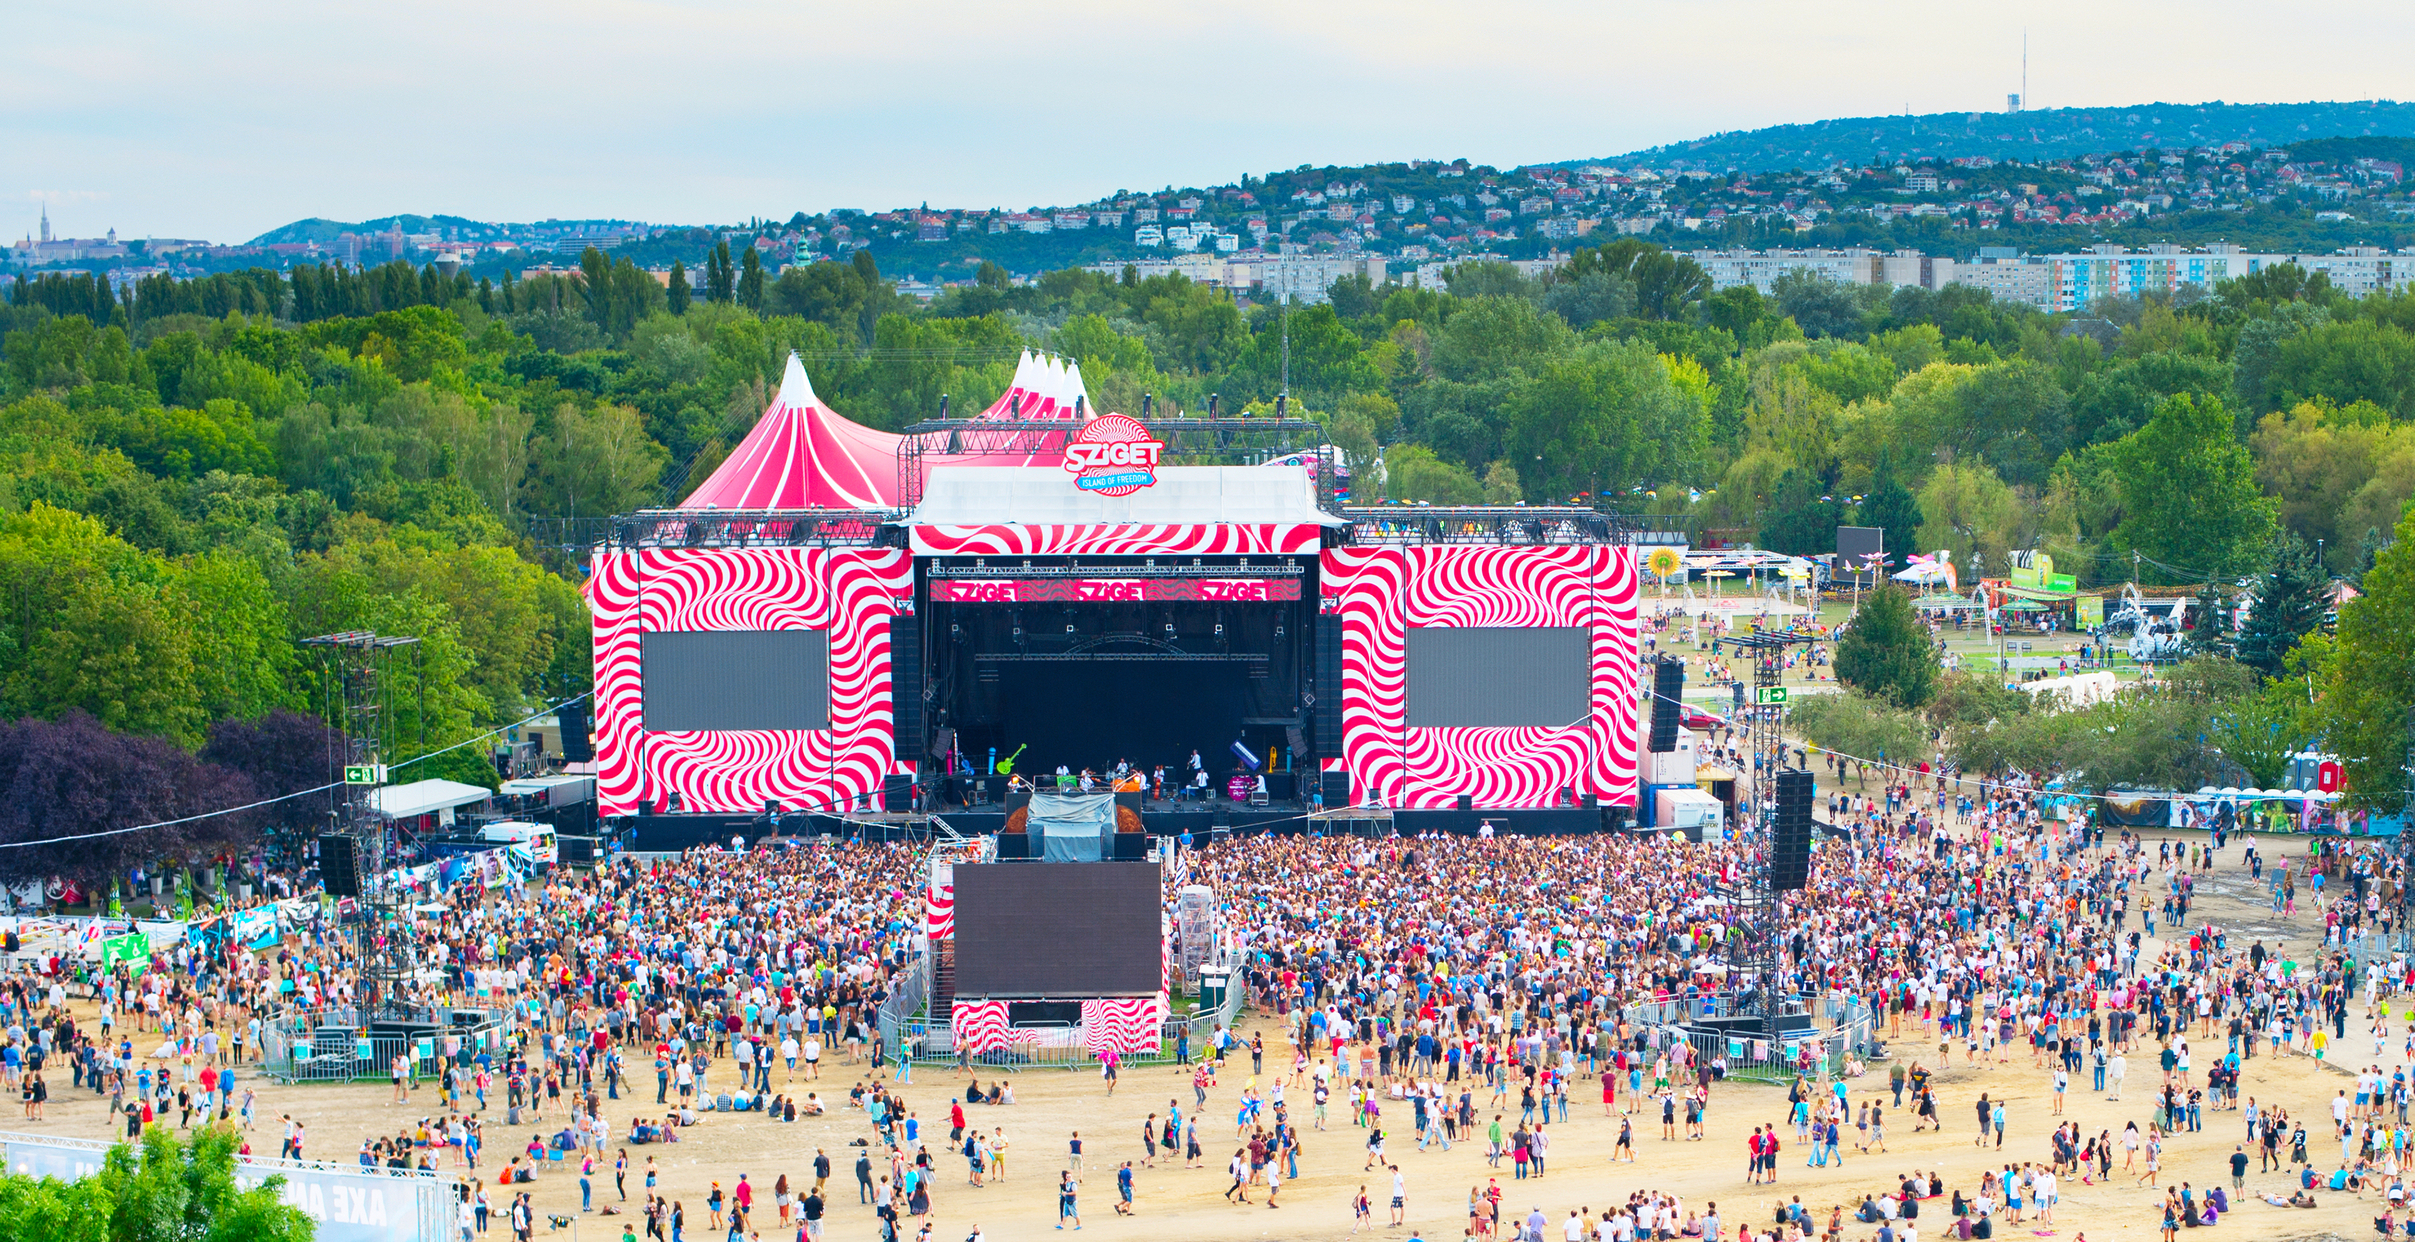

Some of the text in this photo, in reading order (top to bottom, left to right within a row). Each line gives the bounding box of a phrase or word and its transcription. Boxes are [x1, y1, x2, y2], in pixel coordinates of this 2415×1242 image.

[1082, 474, 1147, 487] ISLAND OF FREEDOM
